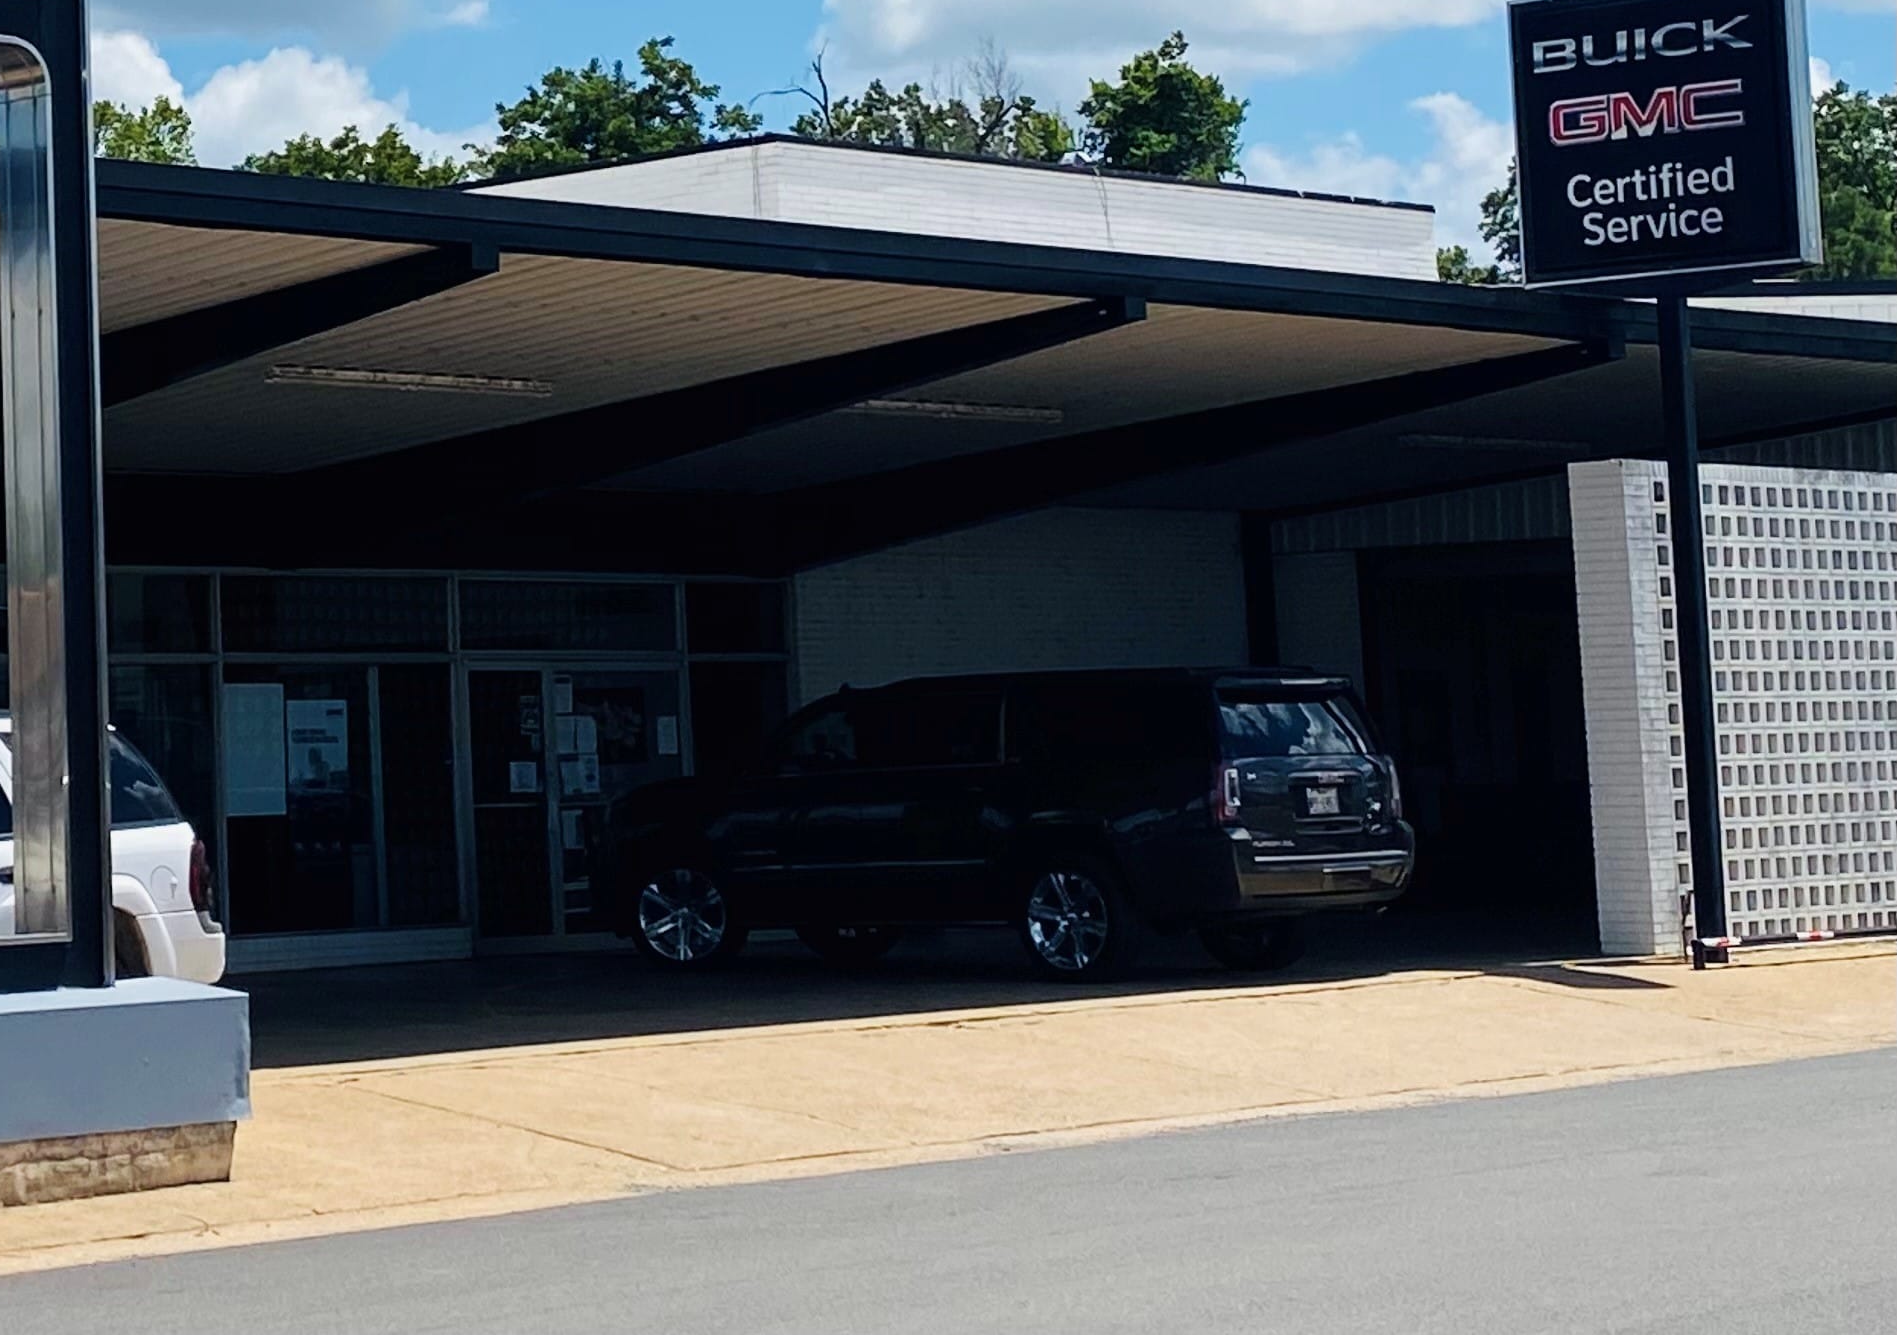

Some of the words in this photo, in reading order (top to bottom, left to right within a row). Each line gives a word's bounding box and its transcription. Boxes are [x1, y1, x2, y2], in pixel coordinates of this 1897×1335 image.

[1533, 14, 1753, 74] BUICK
[1549, 78, 1745, 146] GMC
[1567, 156, 1735, 208] Certified
[1583, 203, 1724, 246] Service
